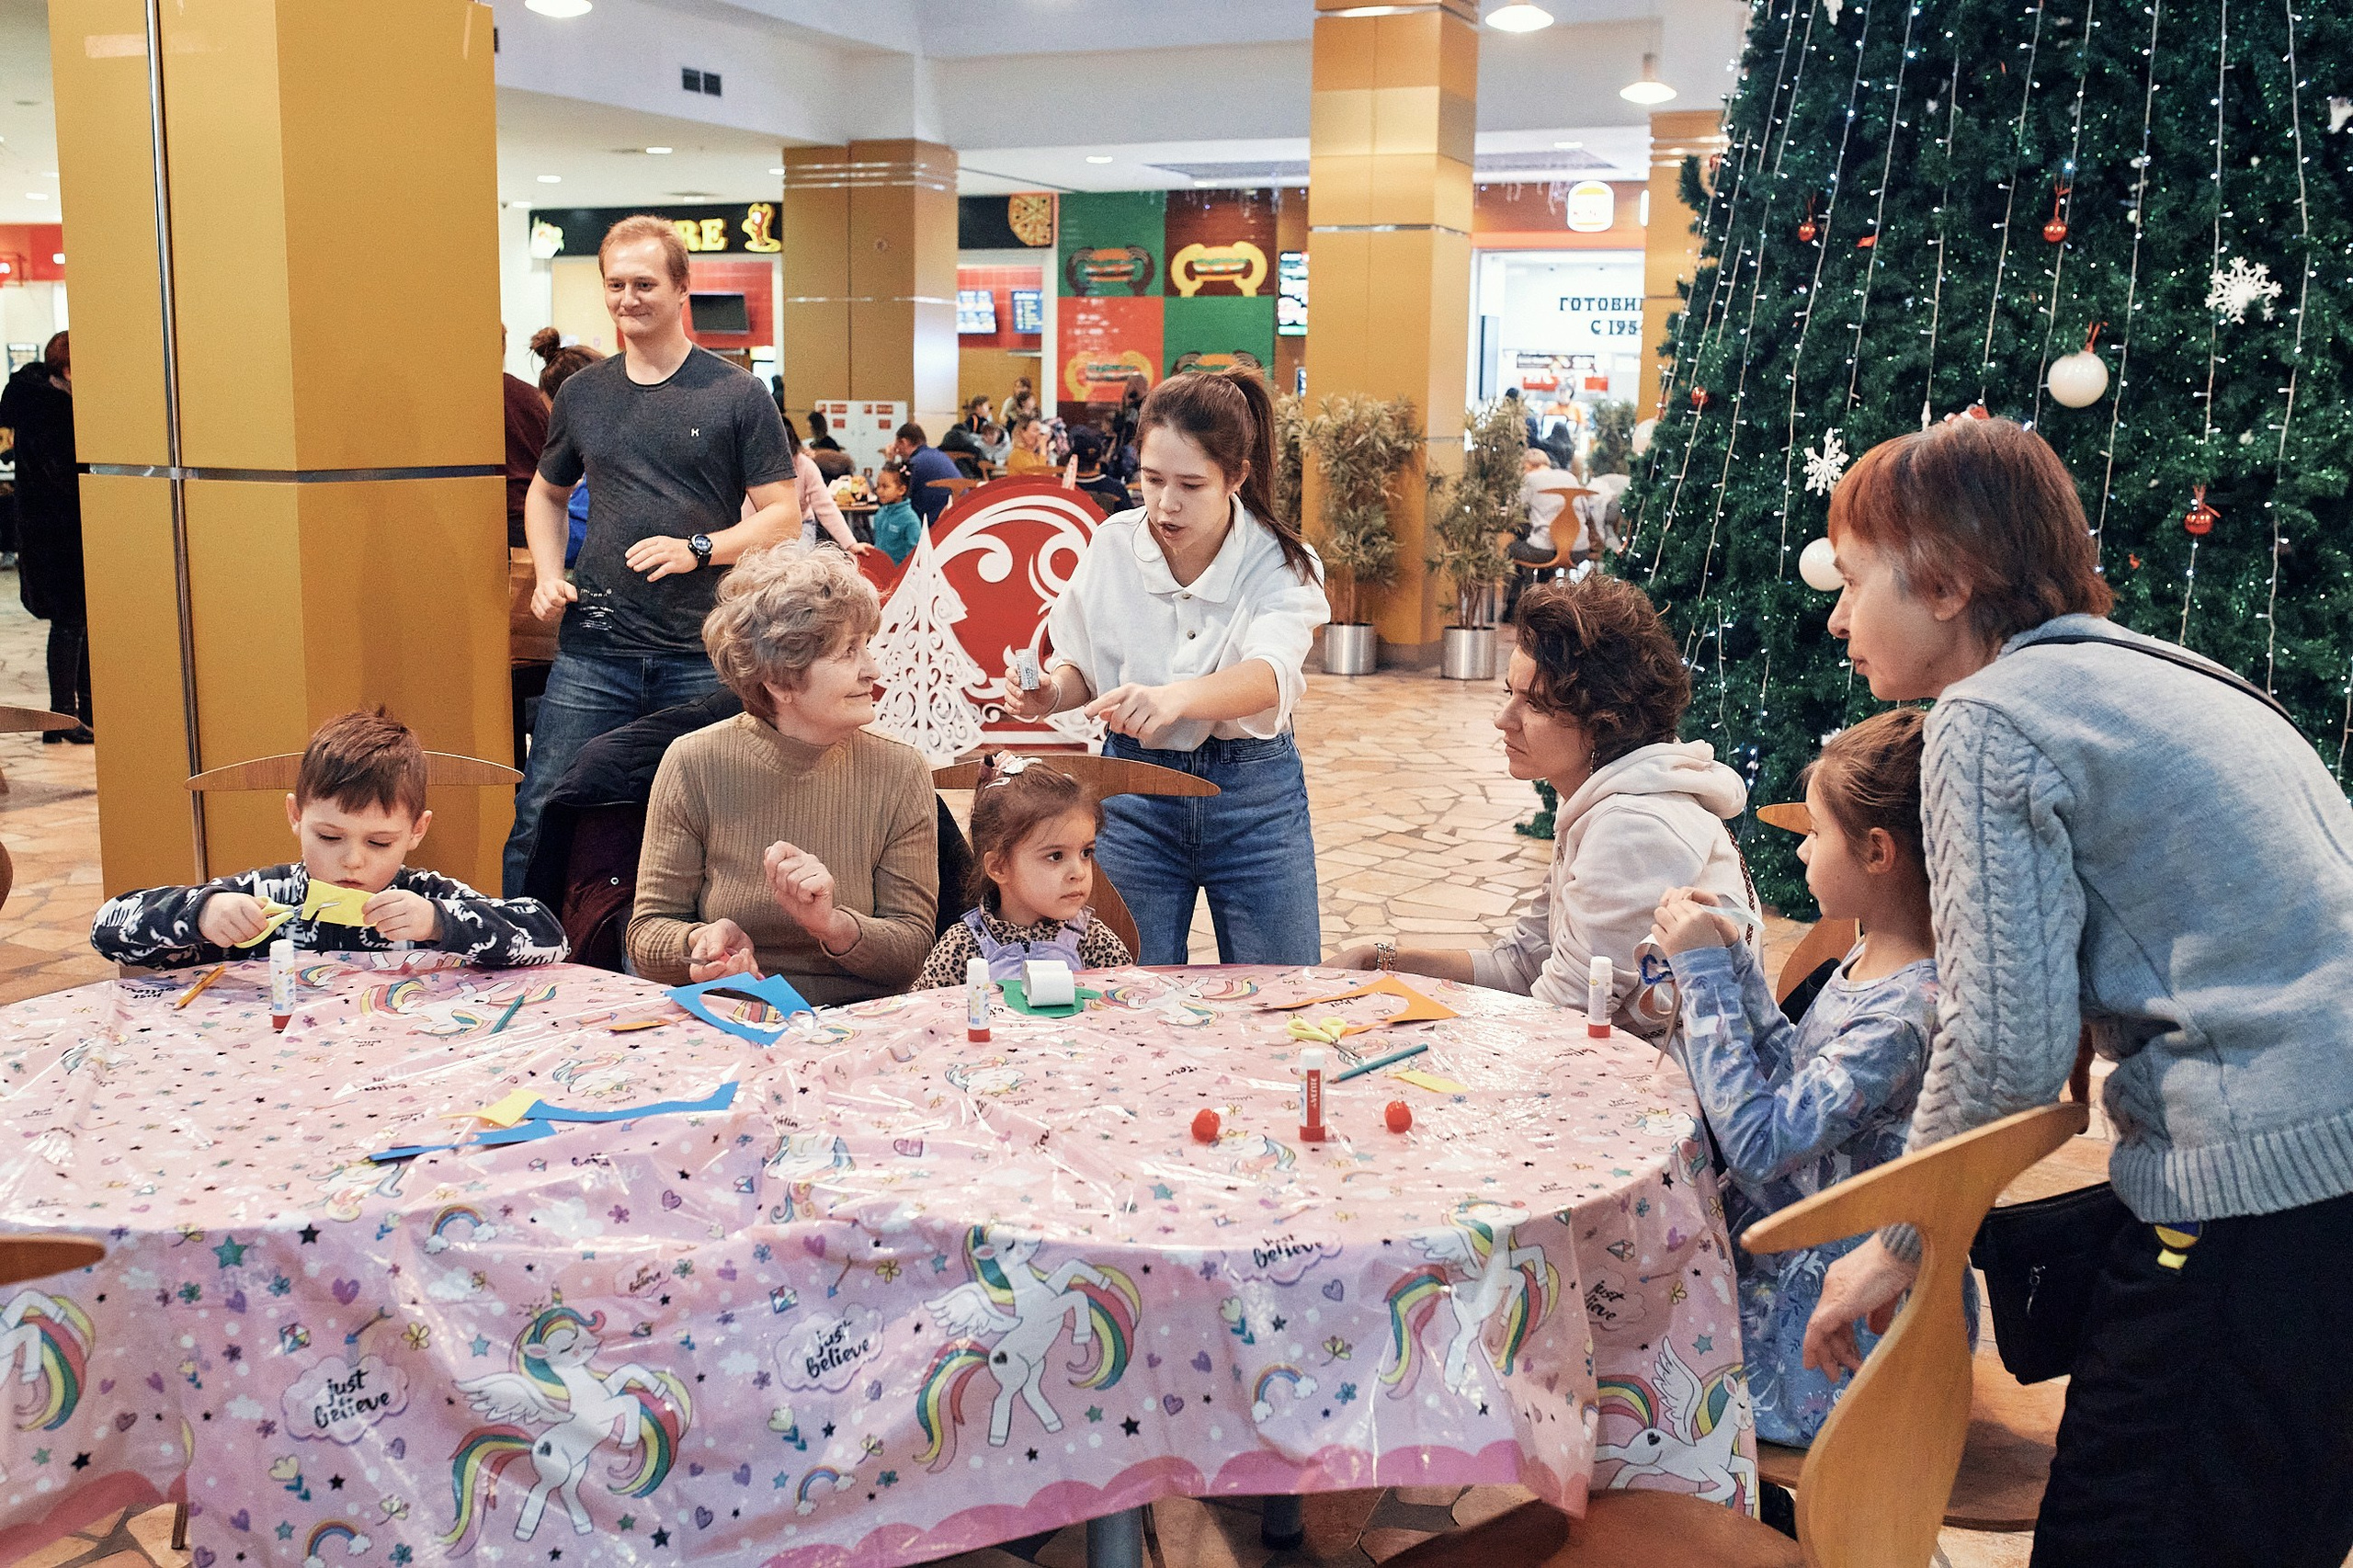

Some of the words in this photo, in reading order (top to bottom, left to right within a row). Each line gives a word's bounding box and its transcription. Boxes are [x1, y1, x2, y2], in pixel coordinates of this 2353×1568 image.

[672, 218, 728, 252] RE
[1560, 297, 1642, 311] ГОТОВИ
[1608, 320, 1637, 335] 195
[1585, 1294, 1617, 1321] lieve
[816, 1319, 854, 1358] just
[806, 1338, 870, 1379] believe
[326, 1369, 370, 1407] just
[313, 1392, 391, 1429] believe
